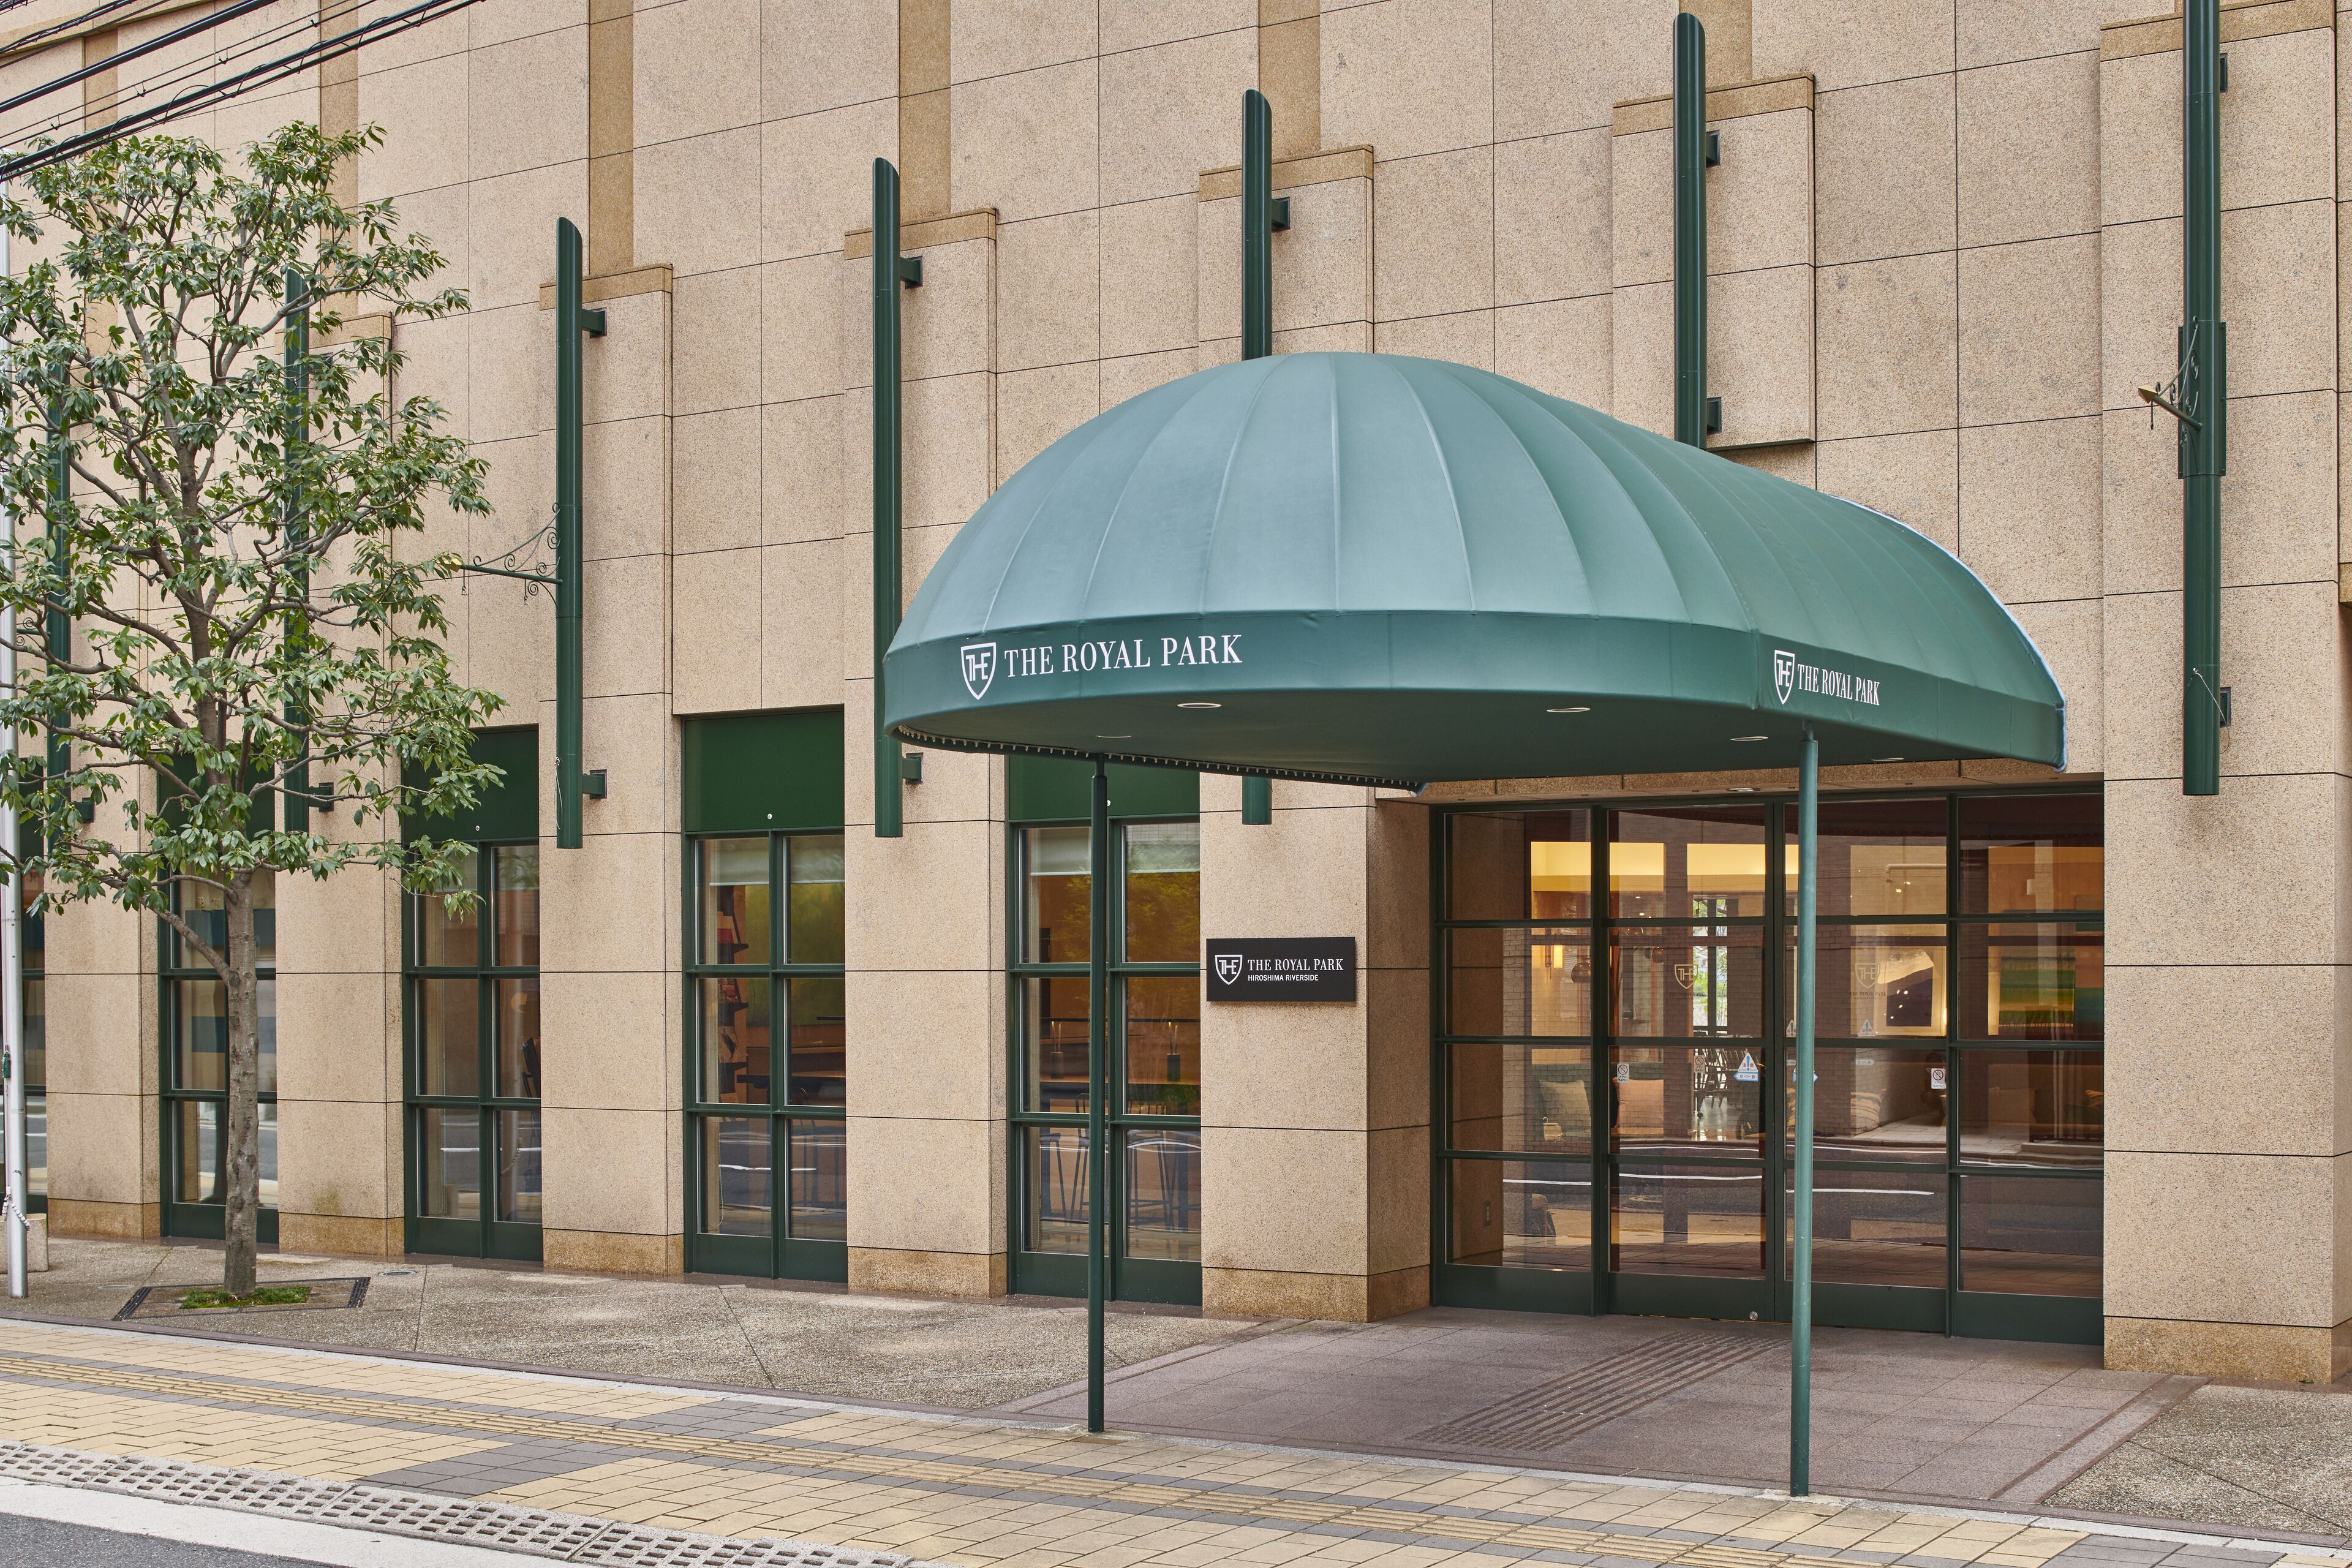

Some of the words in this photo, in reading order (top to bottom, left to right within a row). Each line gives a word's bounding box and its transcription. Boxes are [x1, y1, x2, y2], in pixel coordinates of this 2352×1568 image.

[1004, 646, 1054, 677] THE
[1061, 639, 1150, 673] ROYAL
[1161, 635, 1243, 666] PARK
[1797, 663, 1819, 693] THE
[1822, 668, 1853, 700] ROYAL
[1855, 677, 1880, 706] PARK
[1248, 959, 1272, 971] THE
[1274, 959, 1310, 971] ROYAL
[1313, 959, 1344, 971] PARK
